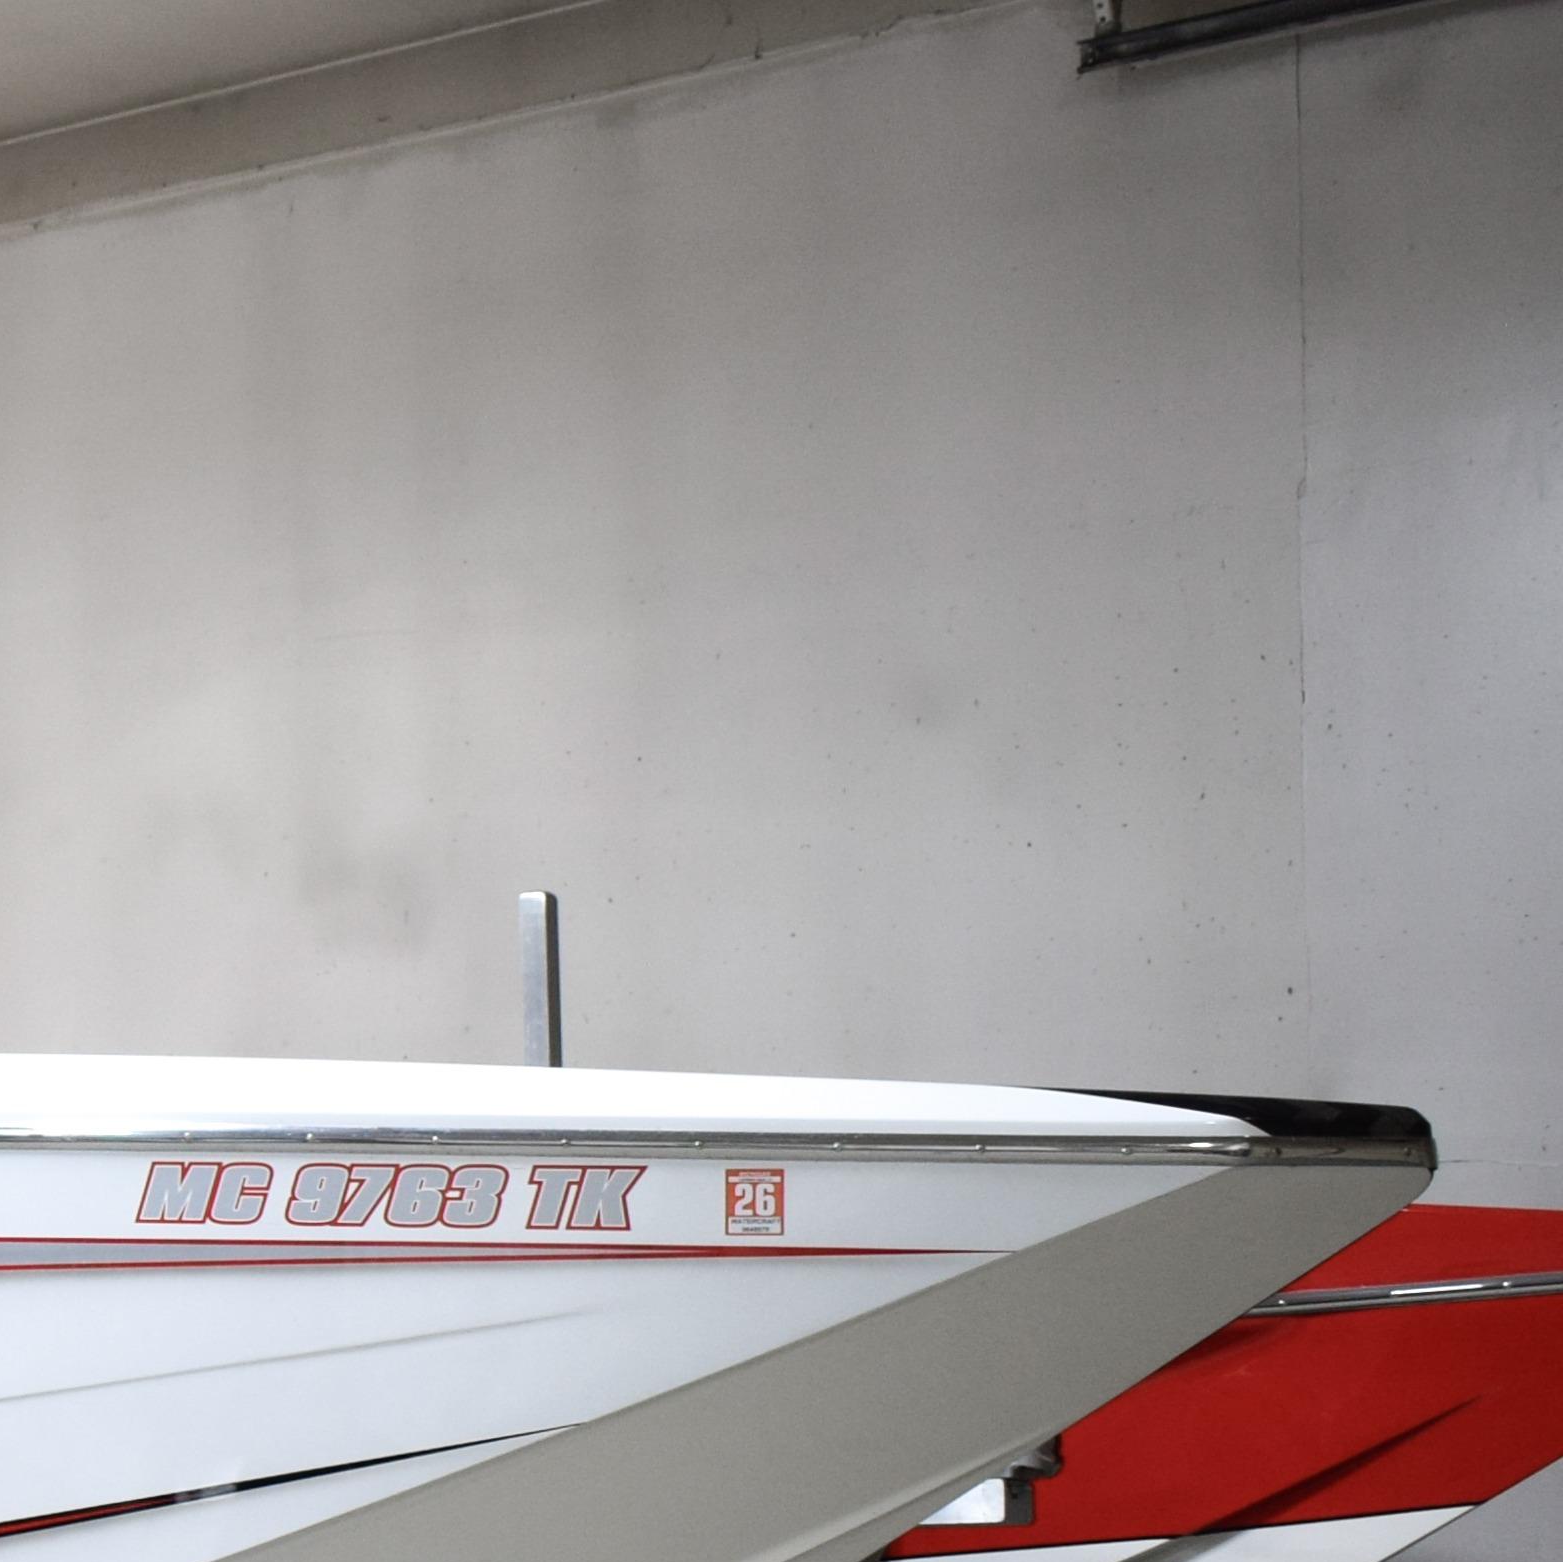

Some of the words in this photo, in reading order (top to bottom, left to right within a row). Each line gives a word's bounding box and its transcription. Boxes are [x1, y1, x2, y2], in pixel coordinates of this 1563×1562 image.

[136, 1161, 274, 1225] MC
[284, 1163, 510, 1229] 9763
[525, 1165, 648, 1230] TK
[734, 1183, 776, 1216] 26
